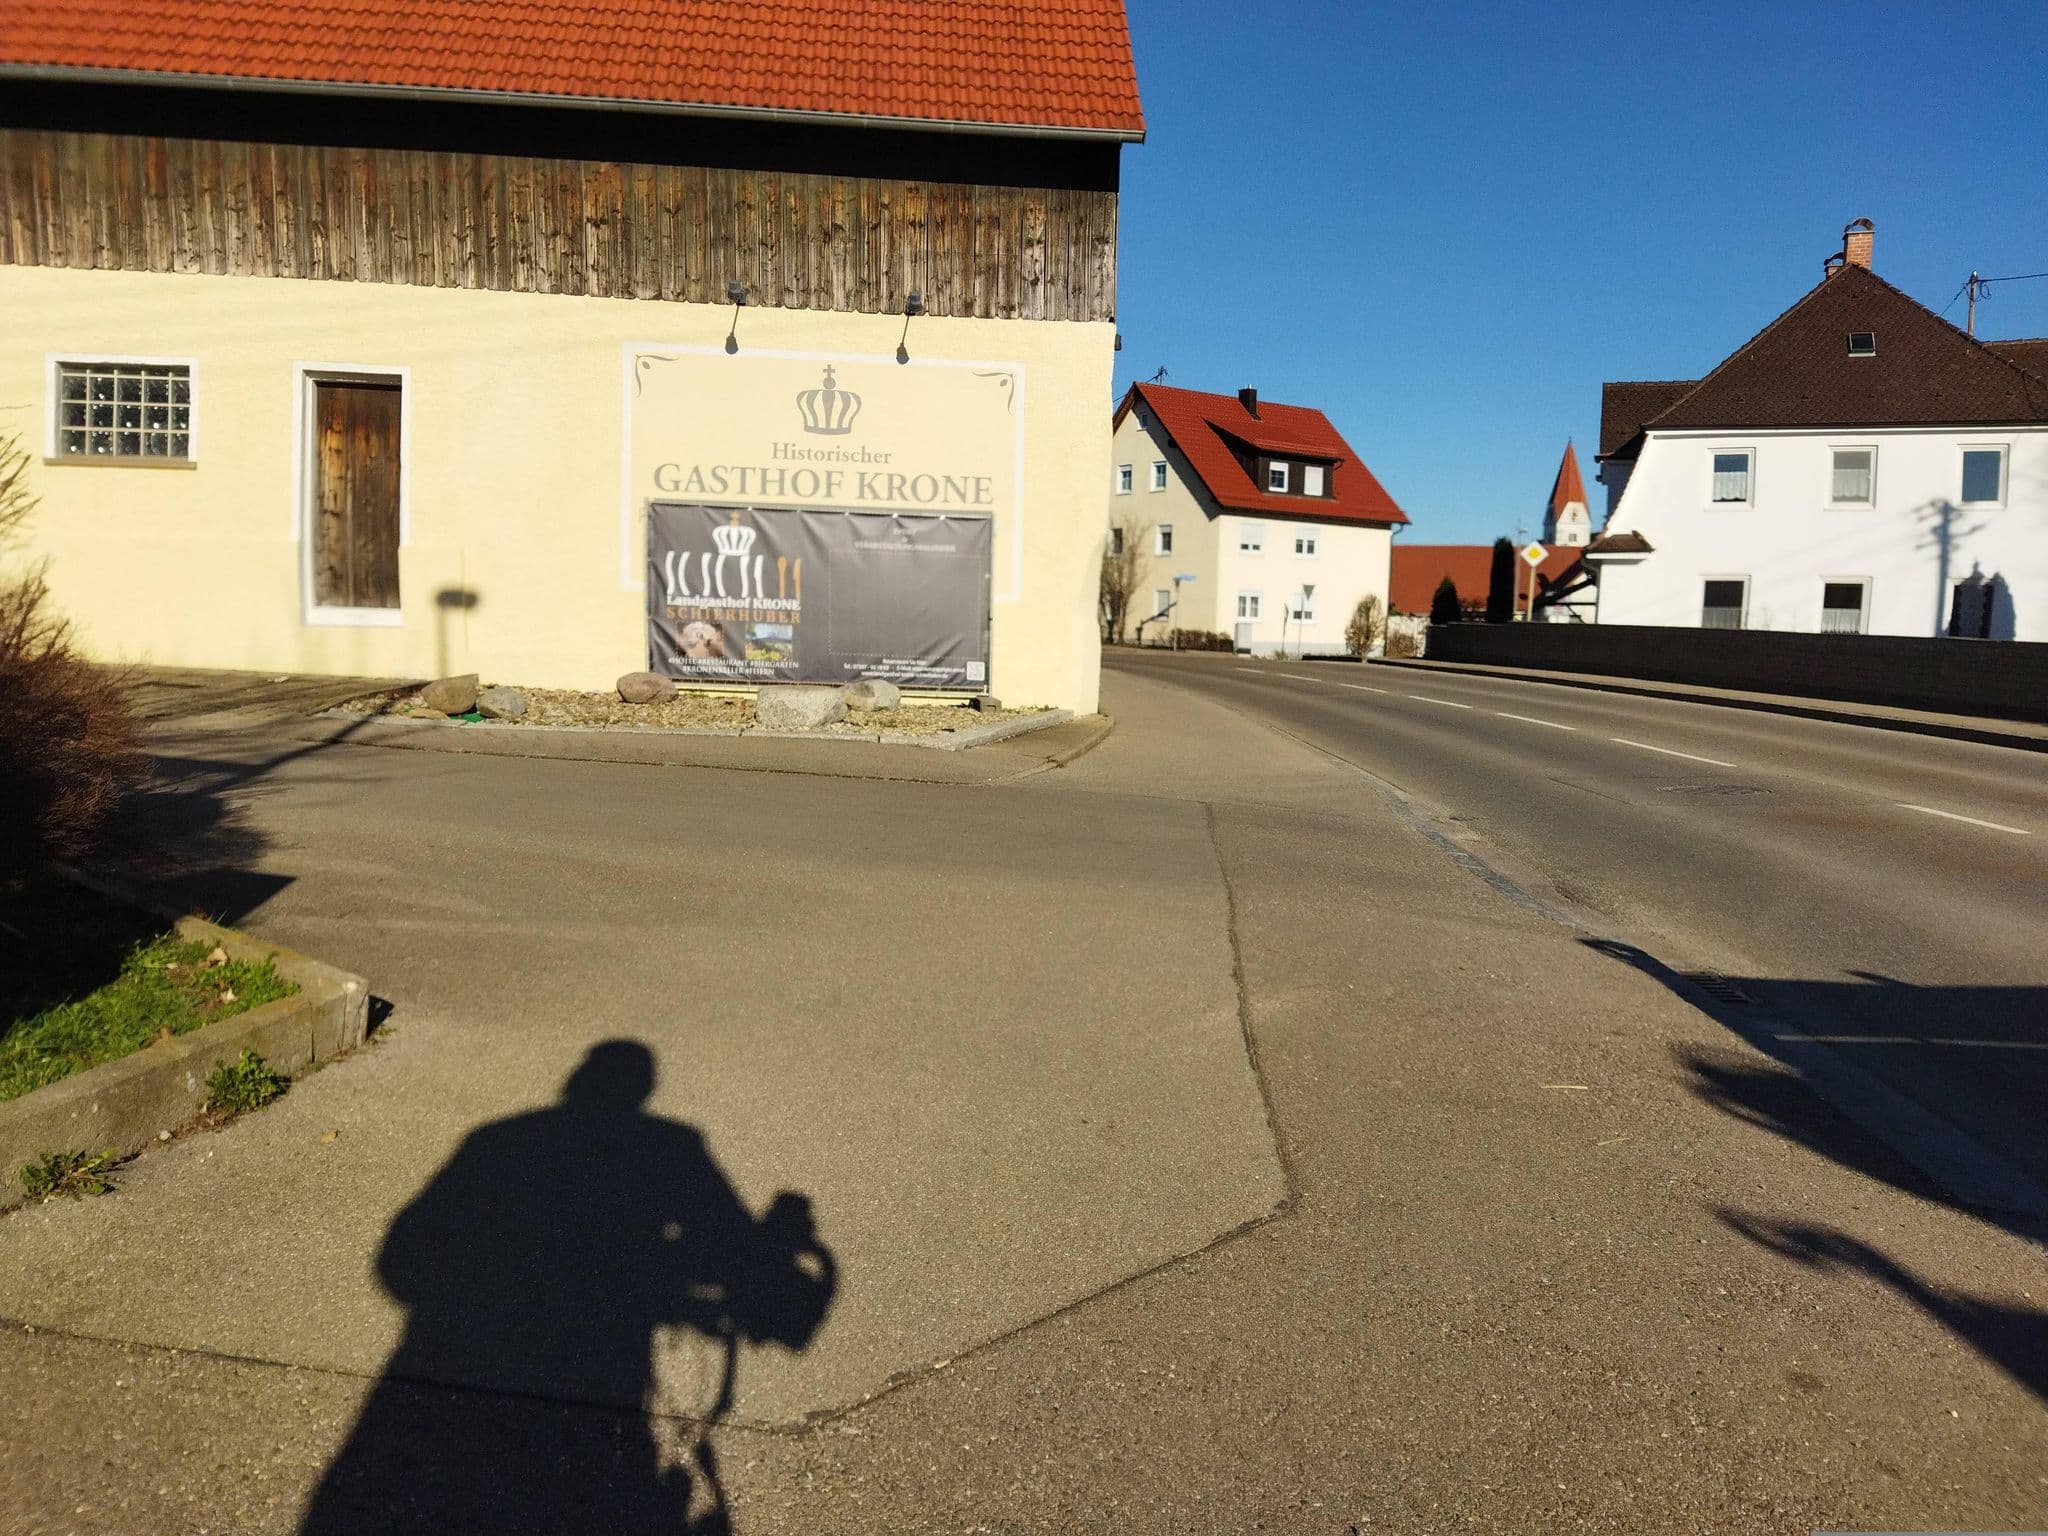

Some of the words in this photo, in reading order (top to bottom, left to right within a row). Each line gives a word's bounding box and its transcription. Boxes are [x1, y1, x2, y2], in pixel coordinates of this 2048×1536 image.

[772, 442, 892, 464] Historischer
[653, 463, 844, 499] GASTHOF
[856, 471, 994, 505] KRONE
[667, 595, 752, 610] Landgasthof
[753, 598, 801, 611] KRONE
[667, 606, 801, 623] SCHIERHUBER
